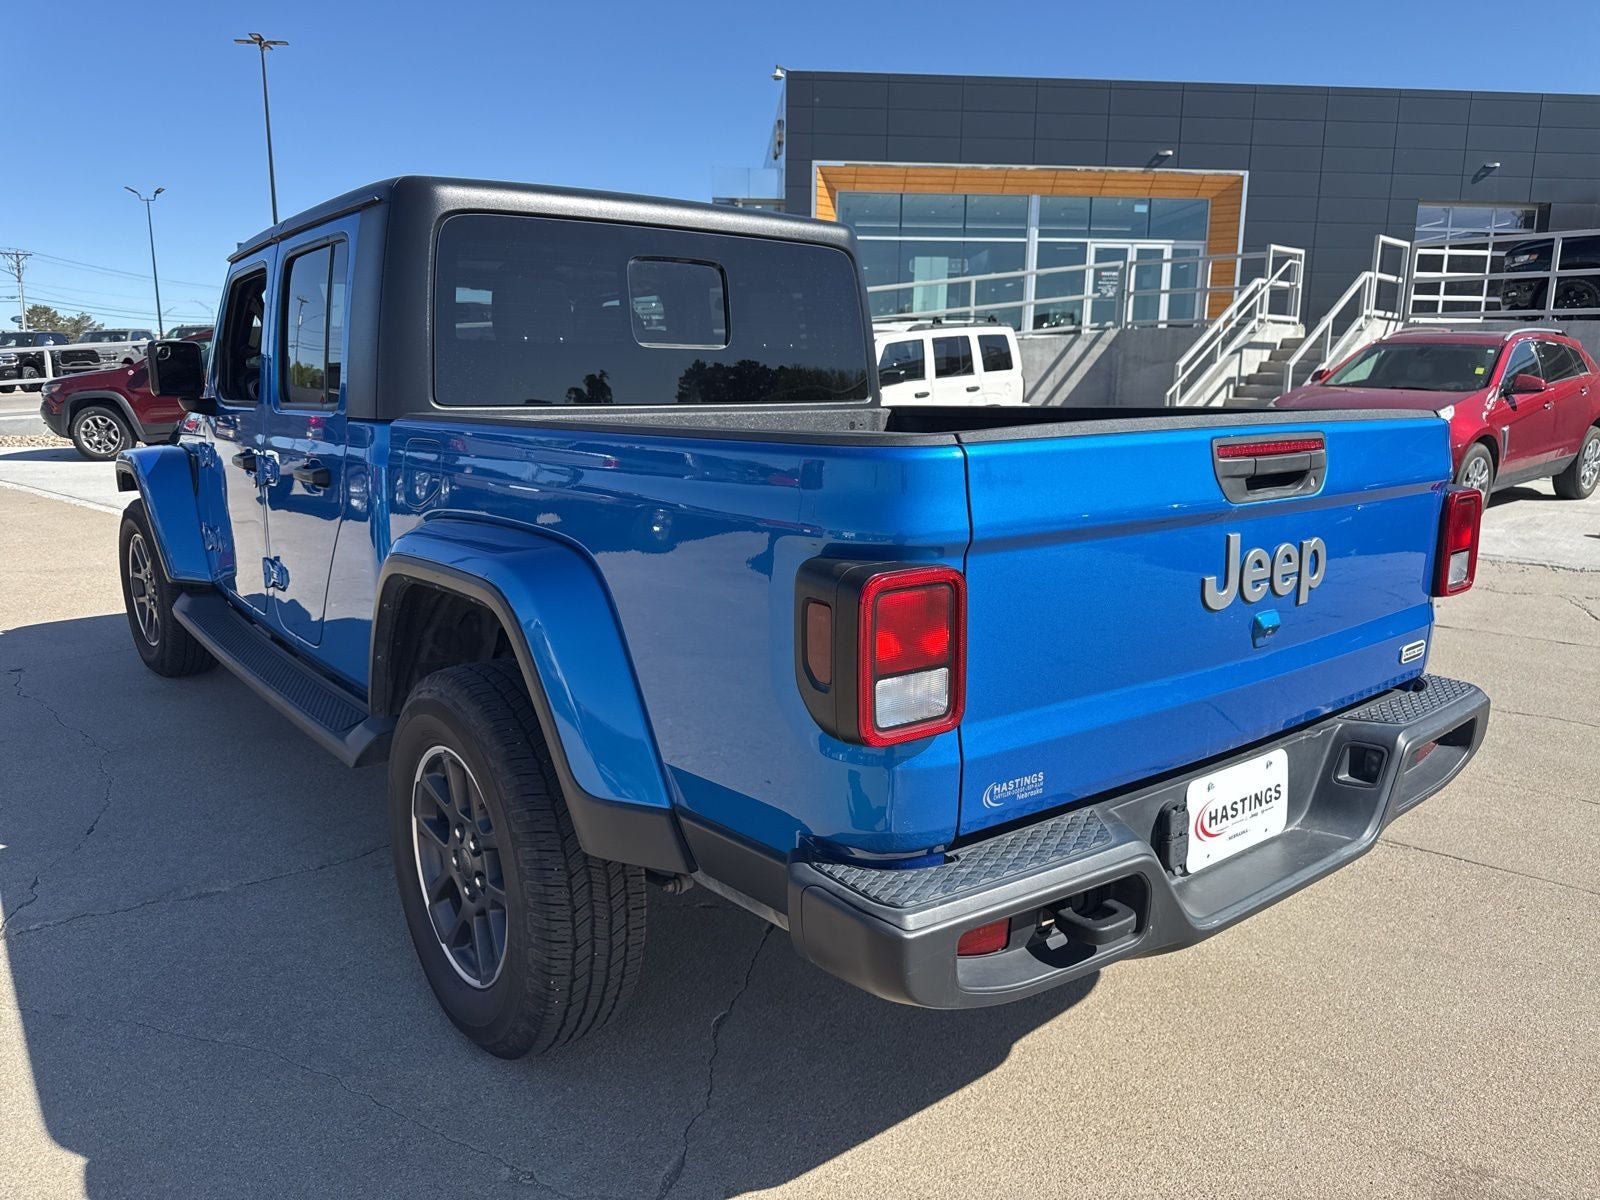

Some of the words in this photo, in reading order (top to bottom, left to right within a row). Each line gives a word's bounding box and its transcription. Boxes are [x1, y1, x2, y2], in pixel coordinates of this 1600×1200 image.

[1201, 532, 1326, 612] Jeep
[993, 772, 1044, 794] HASTINGS
[1208, 783, 1282, 828] HASTINGS
